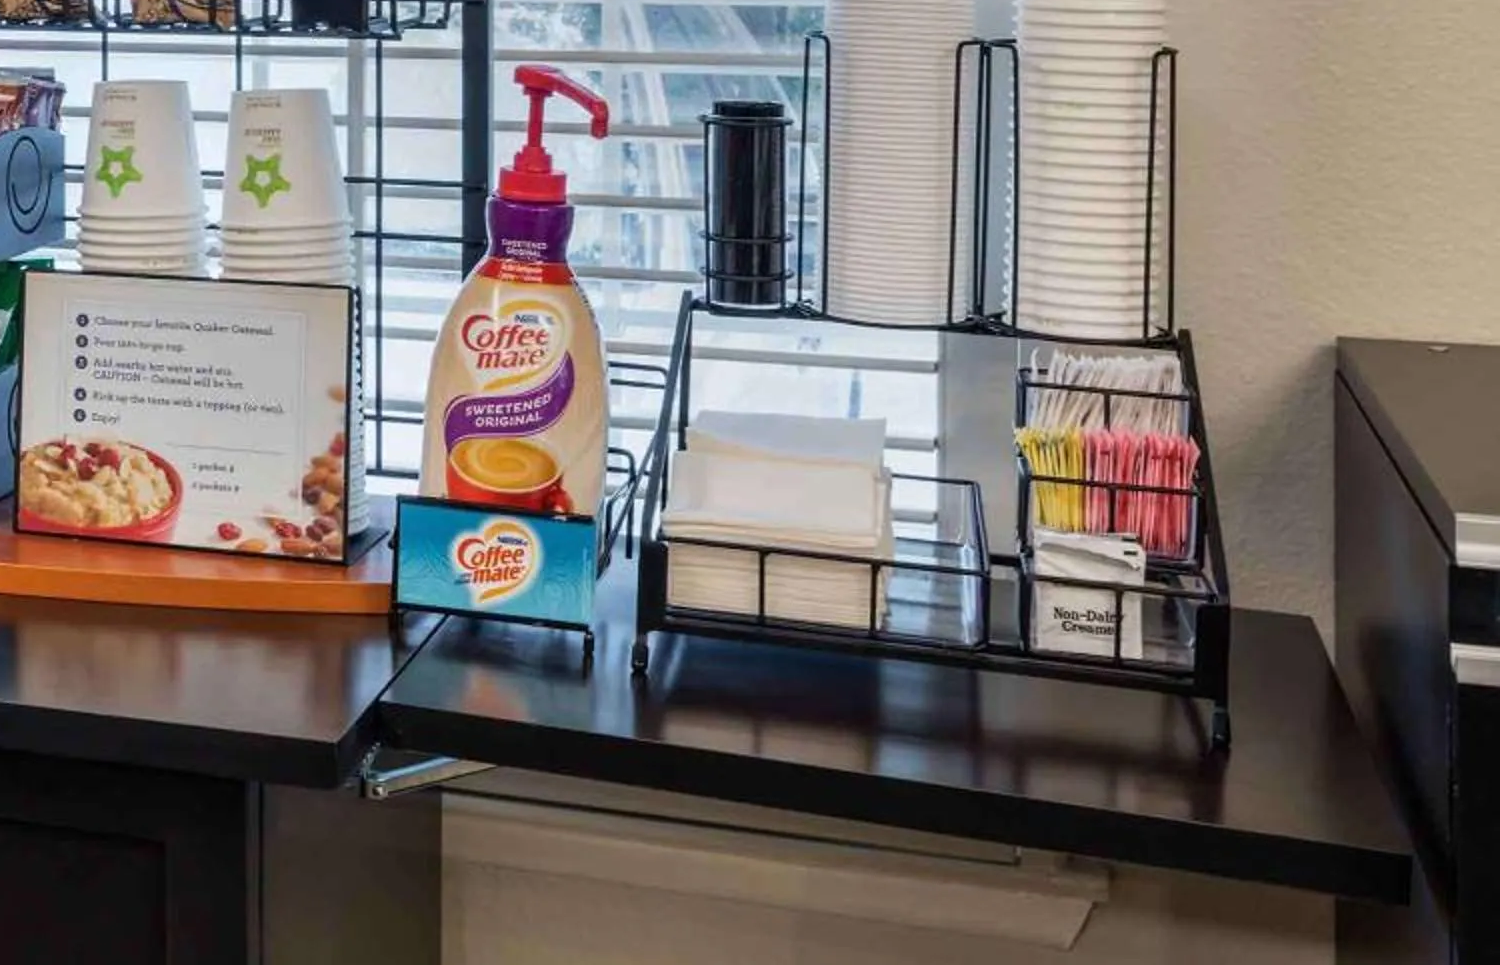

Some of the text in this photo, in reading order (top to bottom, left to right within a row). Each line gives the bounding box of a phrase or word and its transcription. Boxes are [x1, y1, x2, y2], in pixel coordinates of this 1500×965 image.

[461, 314, 549, 352] Coffee
[476, 350, 545, 369] mate
[93, 370, 141, 382] CAUTION
[466, 392, 552, 417] SWEETENED
[475, 411, 543, 428] ORIGINAL
[457, 538, 525, 570] Coffee
[472, 565, 521, 584] mate
